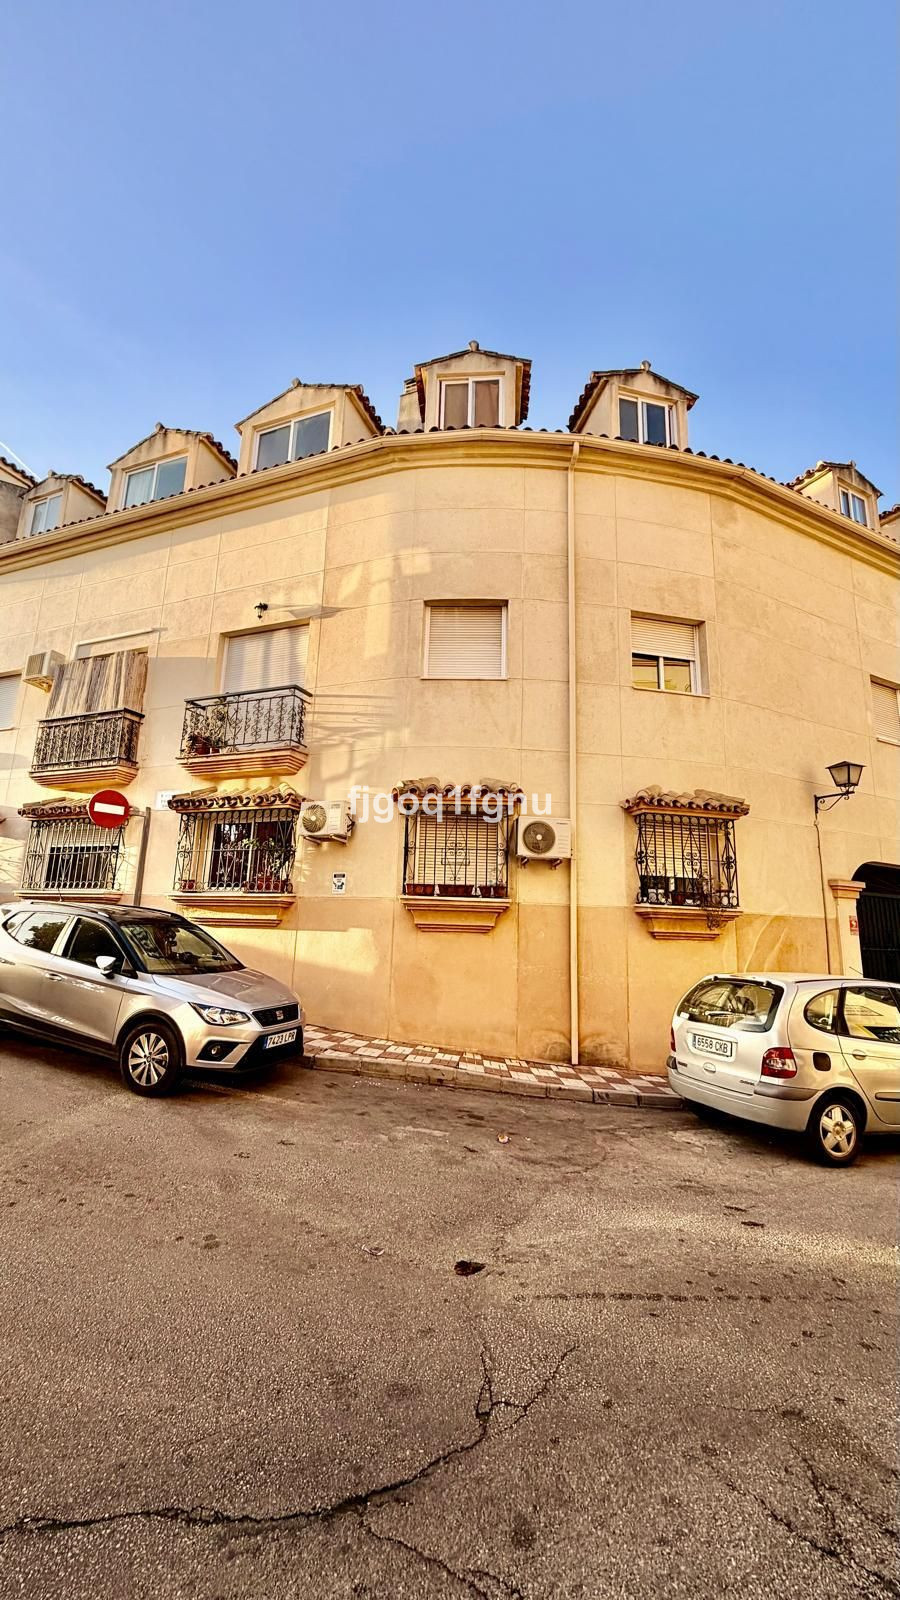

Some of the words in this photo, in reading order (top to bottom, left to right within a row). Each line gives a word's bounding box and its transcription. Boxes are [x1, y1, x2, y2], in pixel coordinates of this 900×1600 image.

[268, 1034, 284, 1046] 7423
[697, 1037, 714, 1050] 6558
[714, 1041, 729, 1054] CKB
